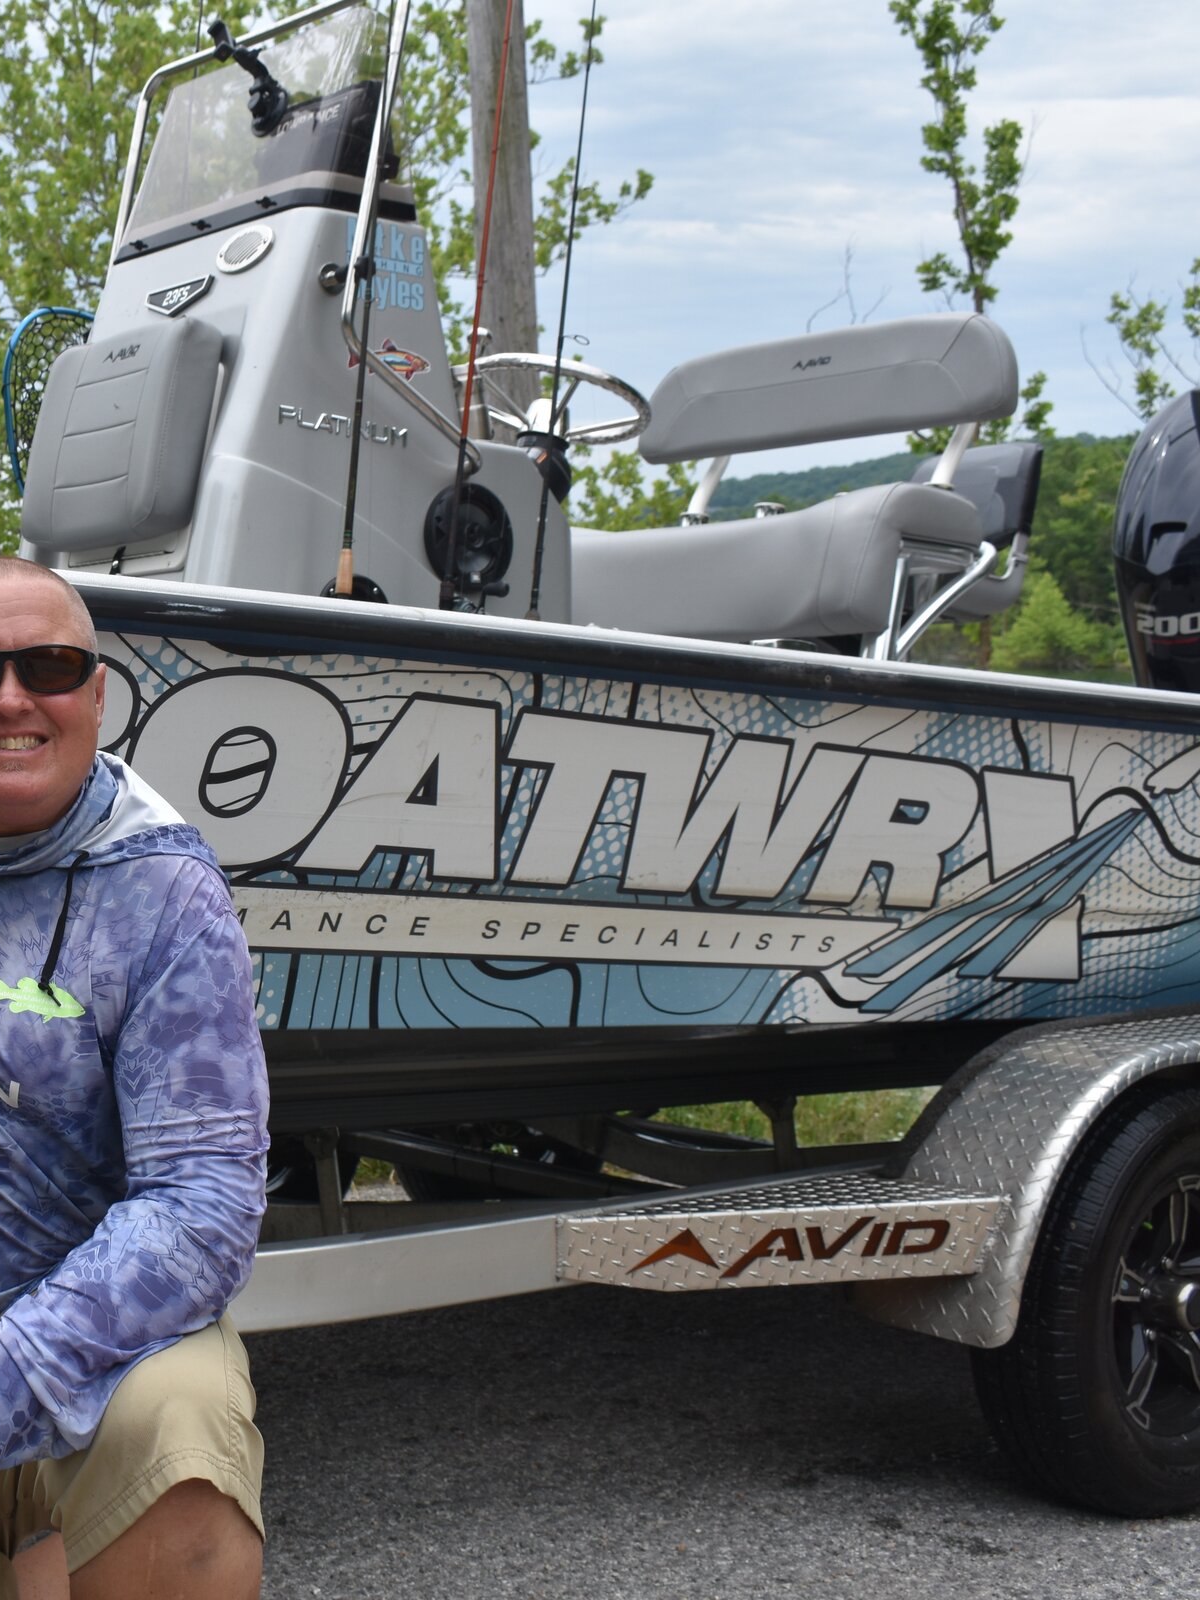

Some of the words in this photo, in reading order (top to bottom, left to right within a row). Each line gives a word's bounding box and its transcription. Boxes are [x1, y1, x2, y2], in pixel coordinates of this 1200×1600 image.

[358, 271, 424, 311] yles
[1136, 611, 1200, 637] 200
[480, 919, 836, 954] SPECIALISTS
[719, 1215, 951, 1279] AVID
